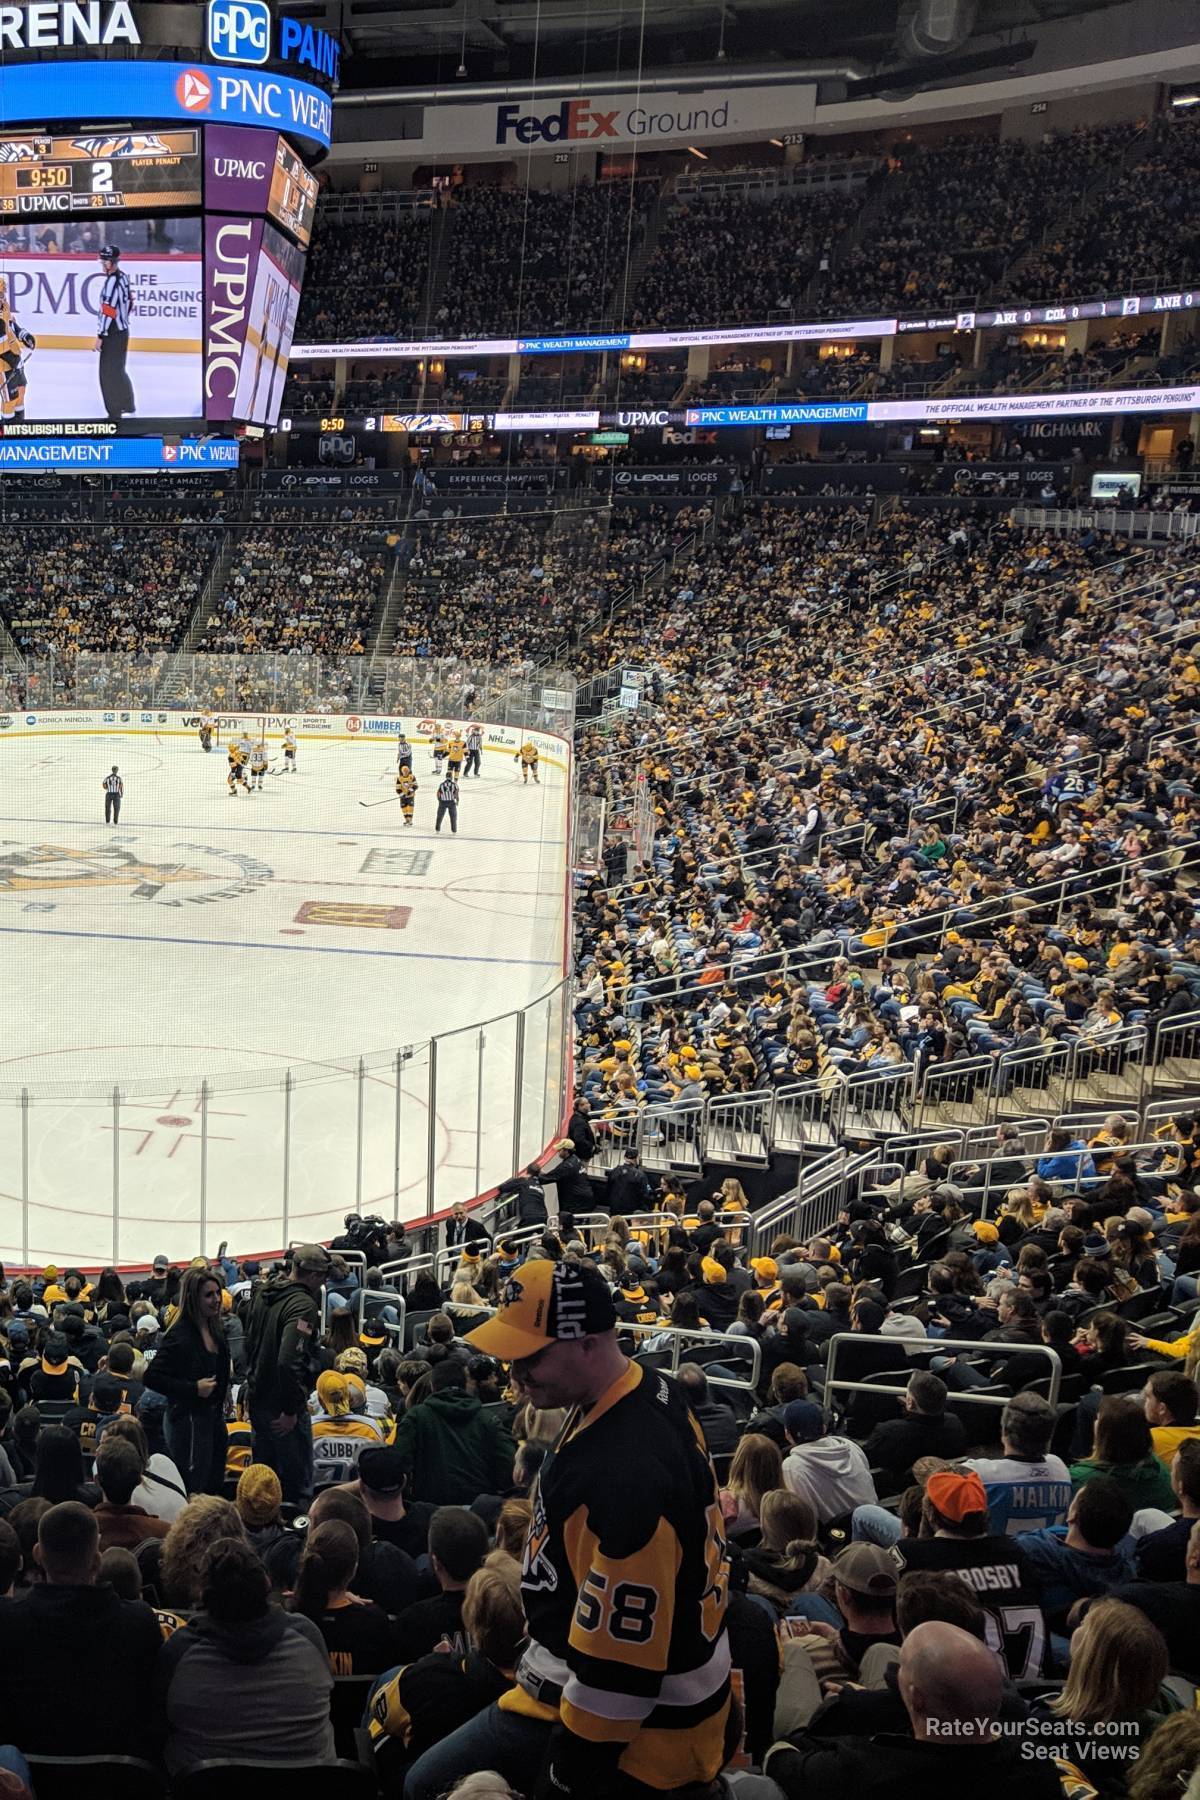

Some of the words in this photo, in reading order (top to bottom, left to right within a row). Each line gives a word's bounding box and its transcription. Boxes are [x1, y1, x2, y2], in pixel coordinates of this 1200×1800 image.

[212, 9, 267, 53] PPG
[217, 78, 282, 117] PNC
[497, 102, 619, 144] FedEx
[626, 101, 729, 137] Ground
[38, 144, 47, 154] 3
[131, 159, 155, 167] PLAYER
[158, 157, 182, 165] PENALTY
[214, 158, 265, 180] UPMC
[32, 168, 67, 187] 9:50
[91, 162, 113, 193] 2
[3, 199, 14, 210] 38
[21, 196, 71, 211] UPMC
[1154, 295, 1181, 309] ANH
[1185, 295, 1192, 305] 0
[205, 221, 252, 399] UPMC
[994, 312, 1017, 325] ARI
[1024, 311, 1031, 322] 0
[1045, 308, 1066, 321] COL
[1072, 307, 1079, 318] 0
[544, 340, 573, 348] WEALTH
[575, 339, 627, 347] MANAGEMENT
[925, 405, 939, 413] THE
[941, 404, 974, 413] OFFICIAL
[977, 402, 1007, 411] WEALTH
[1008, 400, 1054, 410] MANAGEMENT
[1056, 399, 1088, 408] PARTNER
[1089, 397, 1098, 406] OF
[1100, 396, 1113, 405] THE
[1115, 394, 1161, 405] PITTSBURGH
[618, 411, 669, 425] UPMC
[701, 412, 726, 422] PNC
[729, 410, 777, 421] WEALTH
[780, 407, 866, 419] MANAGEMENT
[4, 424, 63, 435] MITSUBISHI
[65, 423, 117, 435] ELECTRIC
[321, 418, 344, 431] 9:50
[365, 418, 375, 430] 2
[471, 420, 482, 430] 25
[1023, 422, 1103, 437] HIGHMARK
[662, 427, 718, 444] FedEx
[321, 436, 354, 455] PPG
[180, 446, 206, 461] PNC
[350, 476, 379, 485] LOGES
[450, 475, 502, 483] EXPERIENCE
[634, 474, 679, 482] LEXUS
[688, 473, 718, 482] LOGES
[1026, 472, 1054, 481] LOGES
[257, 717, 298, 729] UPMC
[363, 720, 401, 731] LUMBER
[253, 754, 264, 762] 33
[575, 1572, 659, 1644] 58
